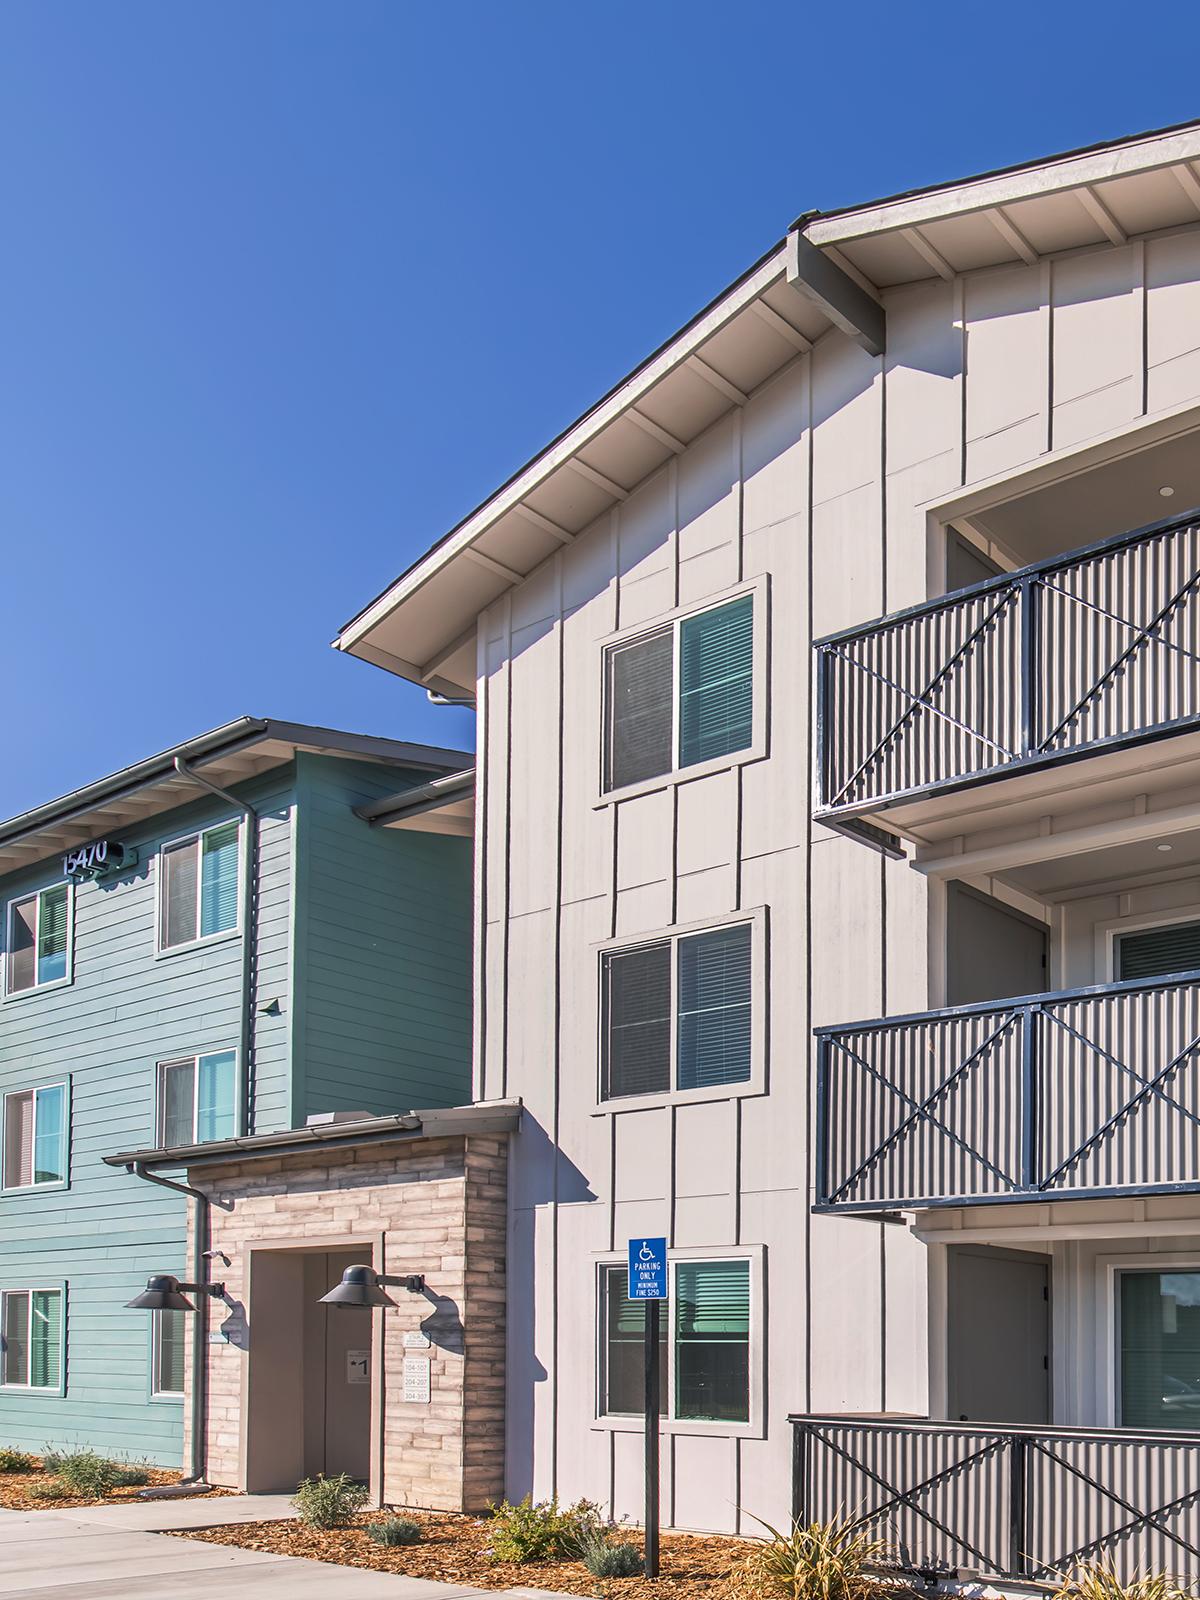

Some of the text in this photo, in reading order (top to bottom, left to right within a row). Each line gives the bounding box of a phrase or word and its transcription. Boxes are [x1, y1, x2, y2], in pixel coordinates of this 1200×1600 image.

[61, 840, 108, 876] 15470
[634, 1261, 661, 1271] PARKING
[639, 1271, 656, 1280] ONLY
[647, 1288, 660, 1296] $250
